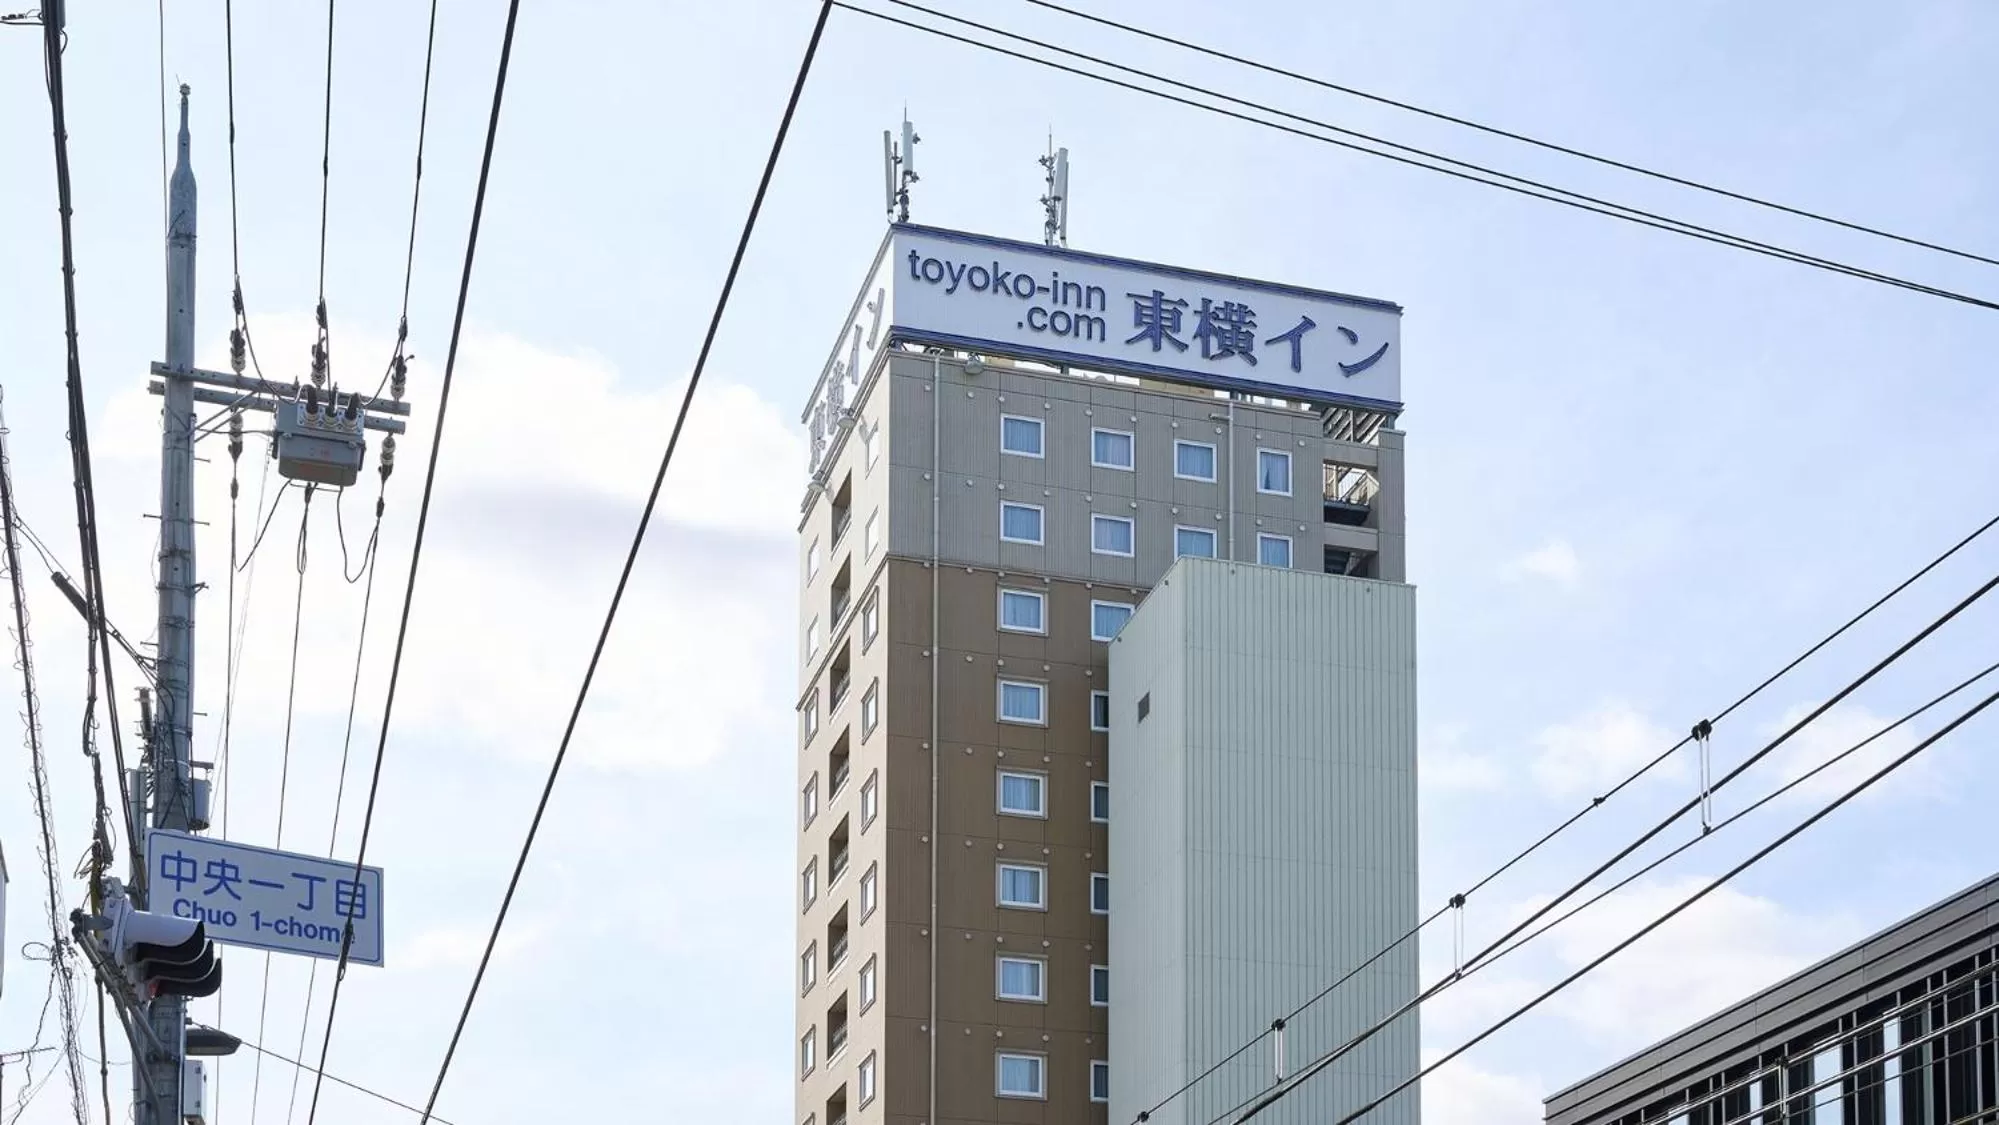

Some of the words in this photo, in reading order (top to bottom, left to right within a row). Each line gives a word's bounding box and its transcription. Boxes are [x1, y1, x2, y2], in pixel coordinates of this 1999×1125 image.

[907, 249, 1106, 311] toyoko-inn
[1016, 305, 1106, 342] .com
[1125, 290, 1390, 377] 東横イン
[160, 850, 366, 919] 中央一丁目
[173, 898, 237, 927] Chuo
